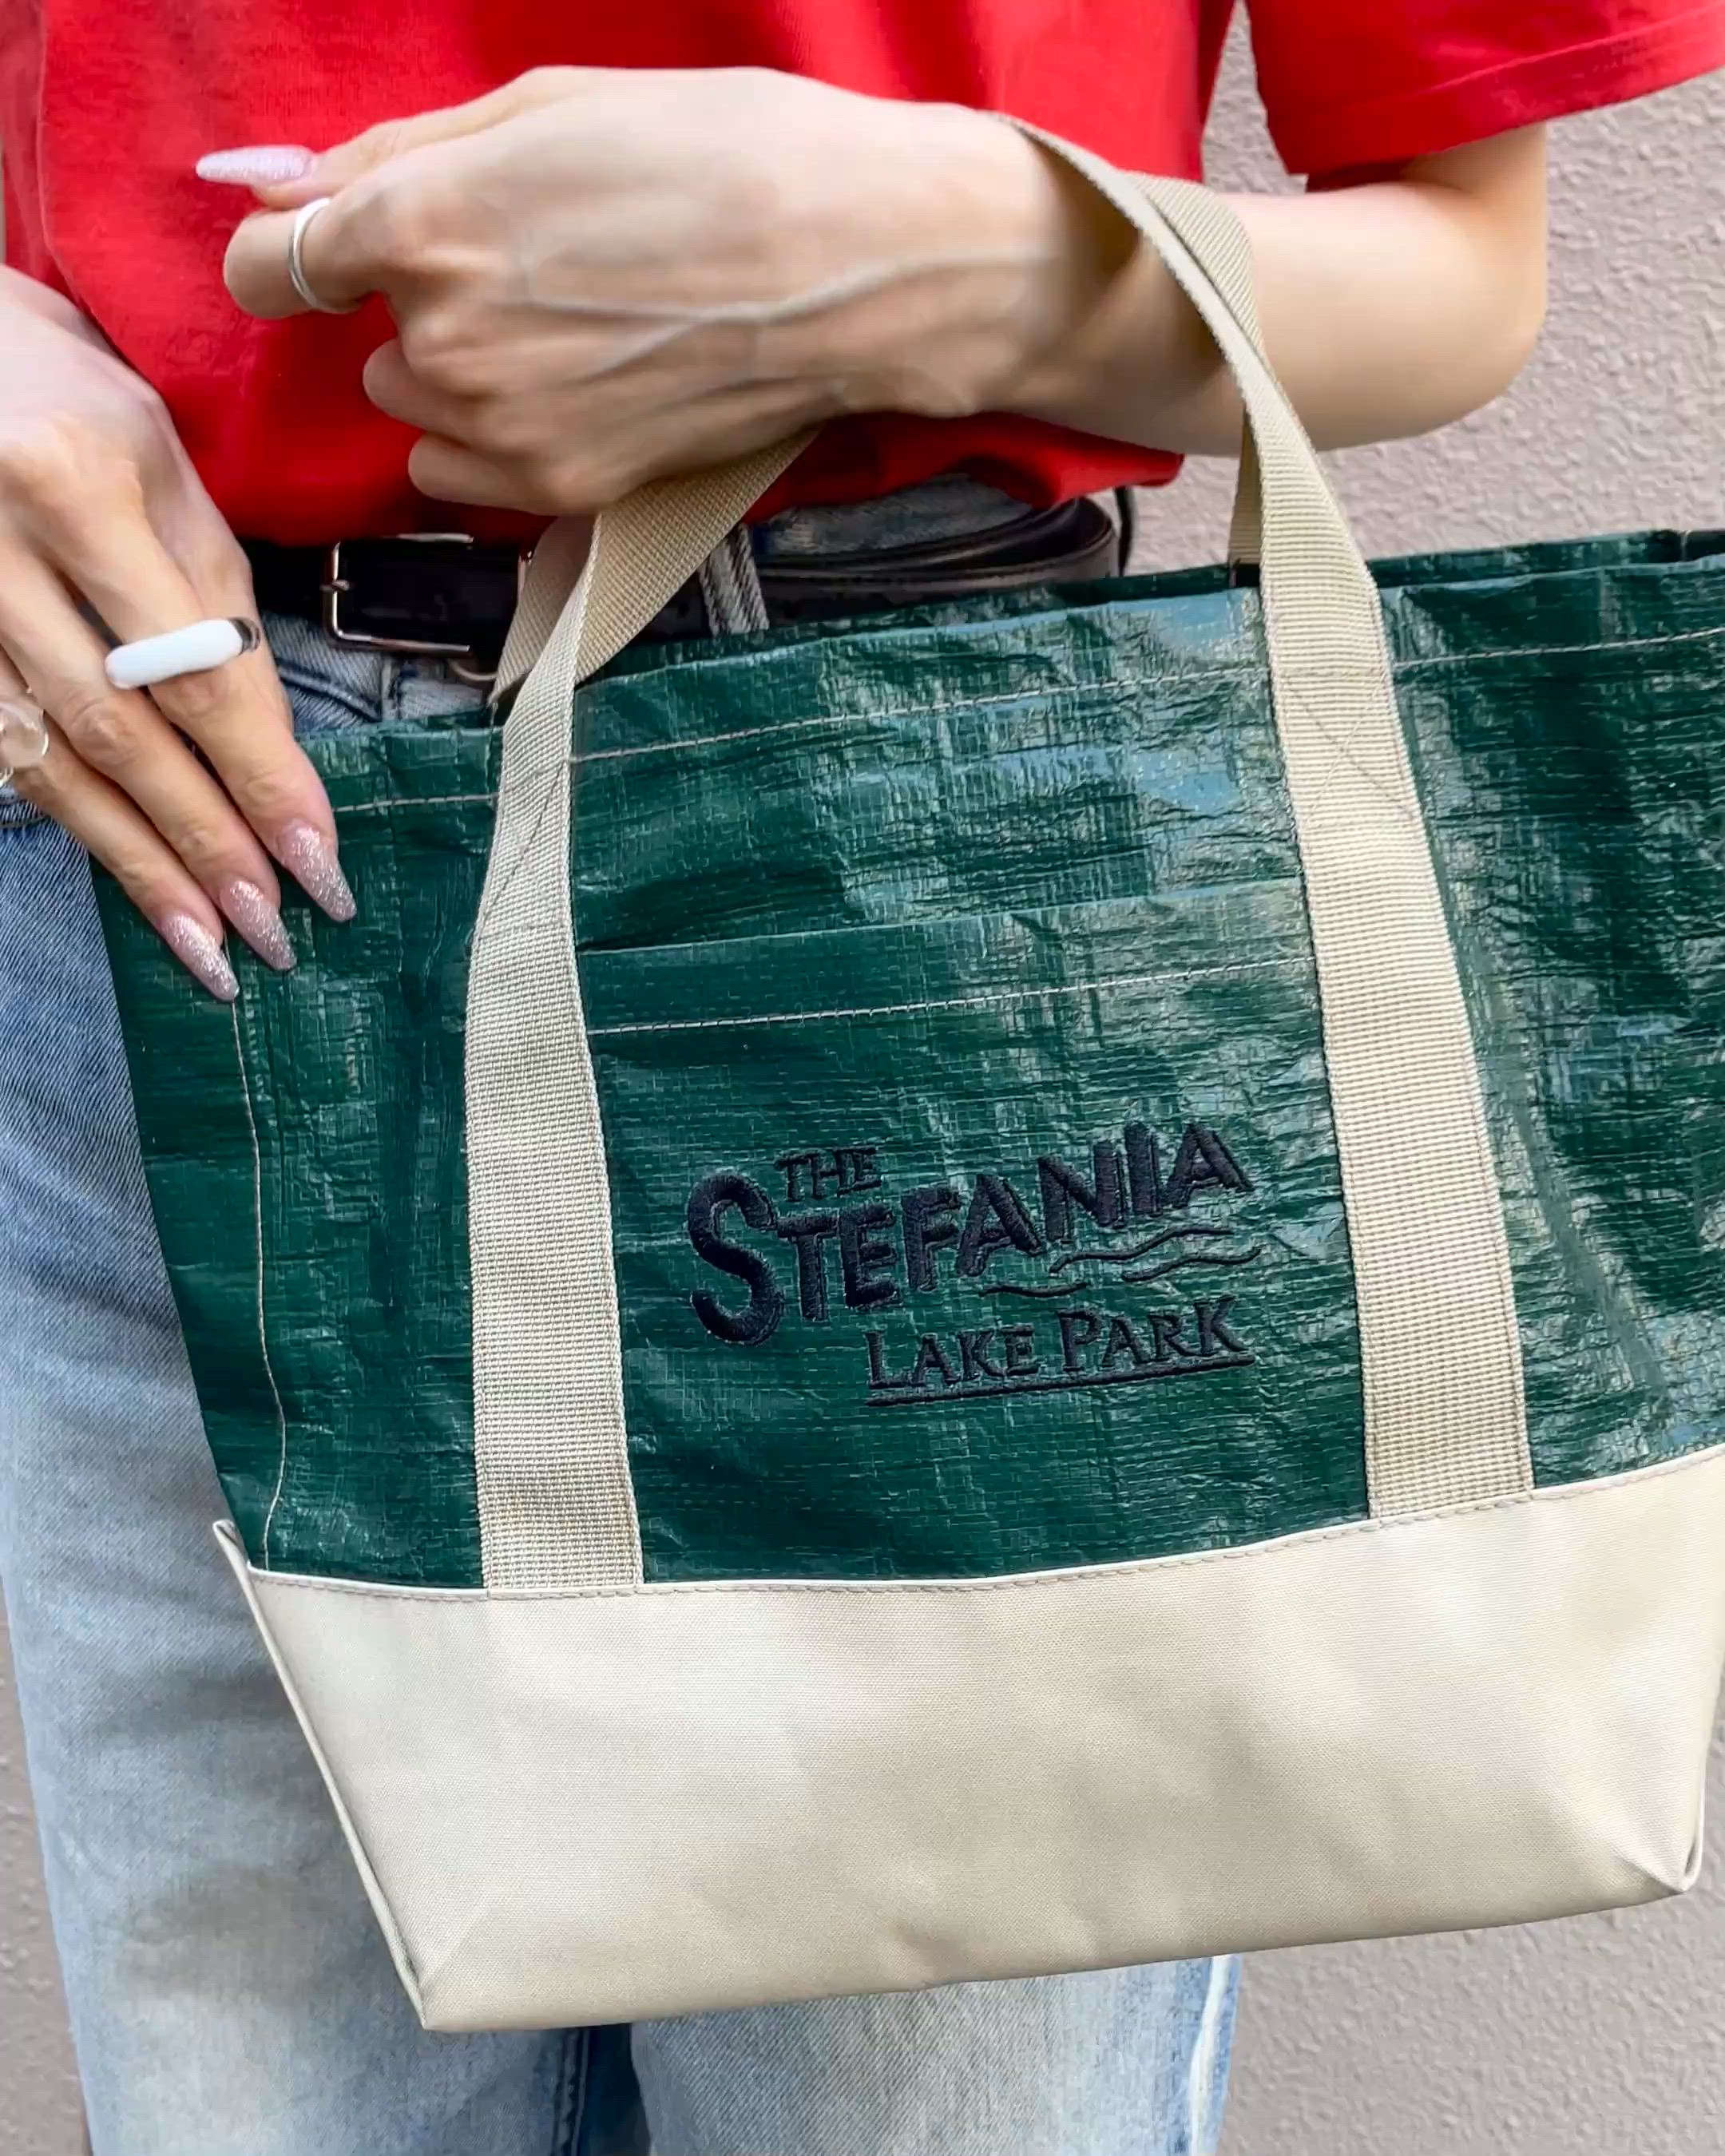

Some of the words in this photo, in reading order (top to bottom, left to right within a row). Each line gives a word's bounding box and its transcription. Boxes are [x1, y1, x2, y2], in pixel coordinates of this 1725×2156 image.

[774, 1145, 882, 1203] THE
[687, 1120, 1255, 1346] STEFANIA
[865, 1324, 1040, 1389] LAKE
[1057, 1294, 1249, 1373] PARK
